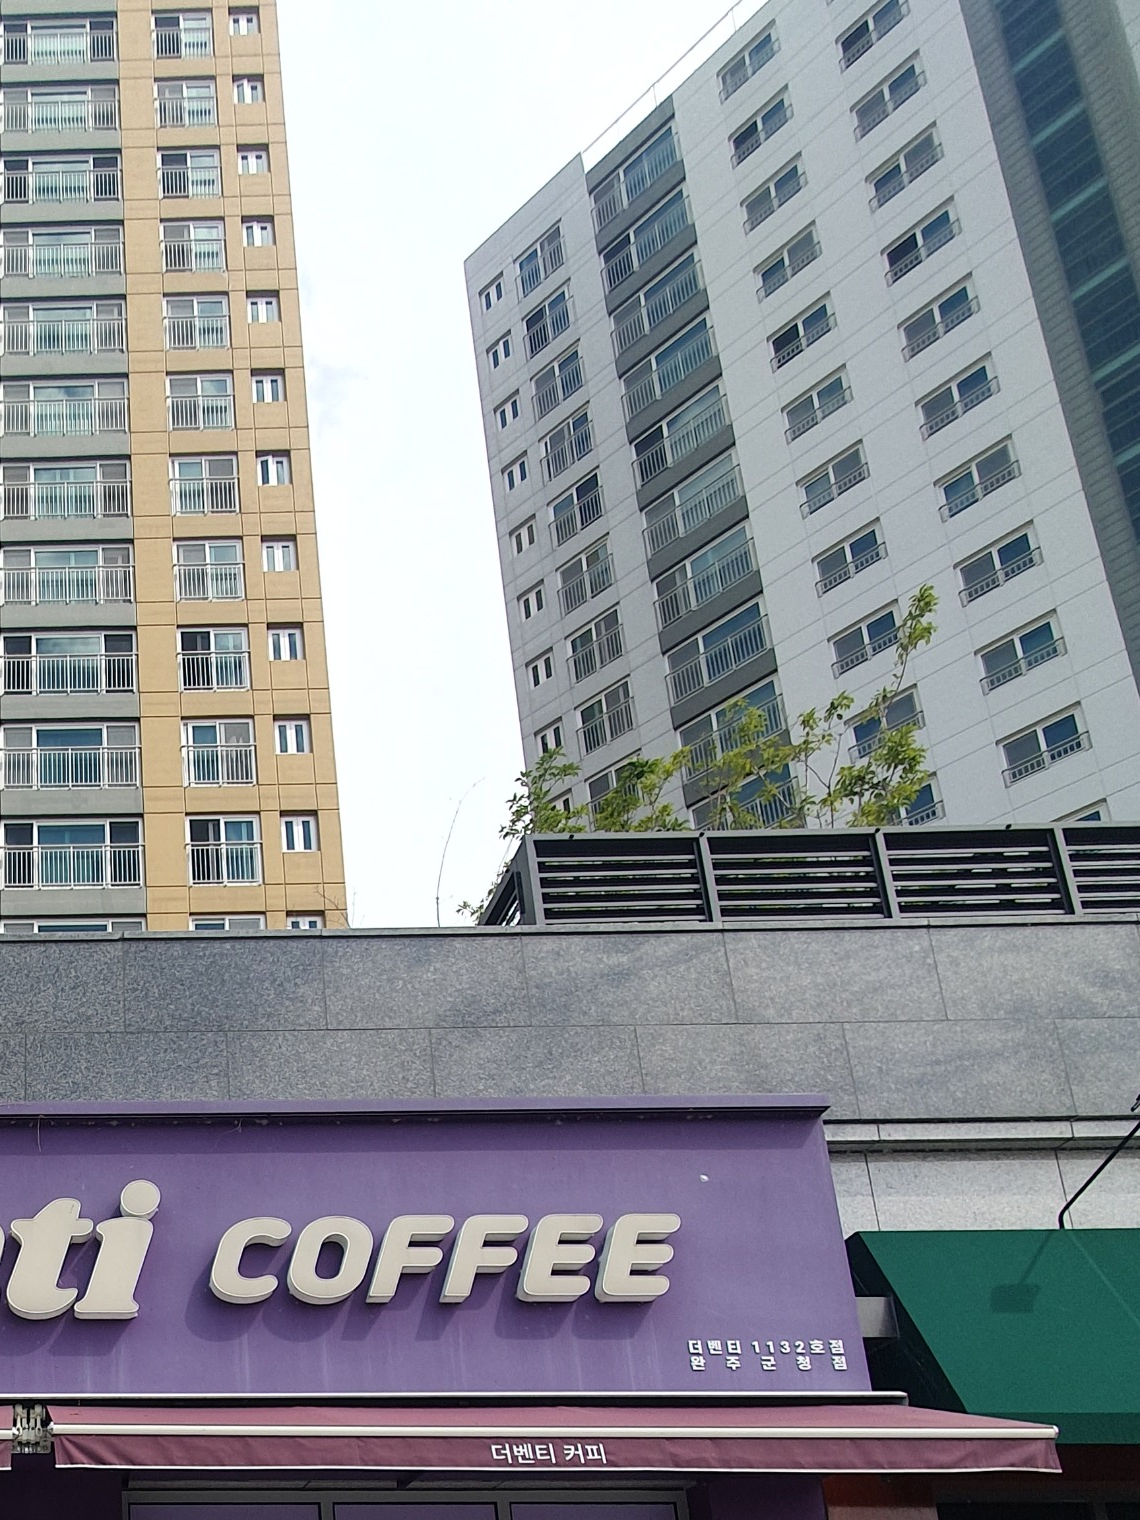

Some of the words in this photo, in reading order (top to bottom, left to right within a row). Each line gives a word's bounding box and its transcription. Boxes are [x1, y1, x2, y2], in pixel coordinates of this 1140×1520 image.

[209, 1213, 682, 1305] COFFEE
[688, 1340, 742, 1355] 더벤티
[751, 1340, 845, 1355] 1132호점
[491, 1443, 556, 1464] 더벤티
[563, 1443, 607, 1464] 커피
